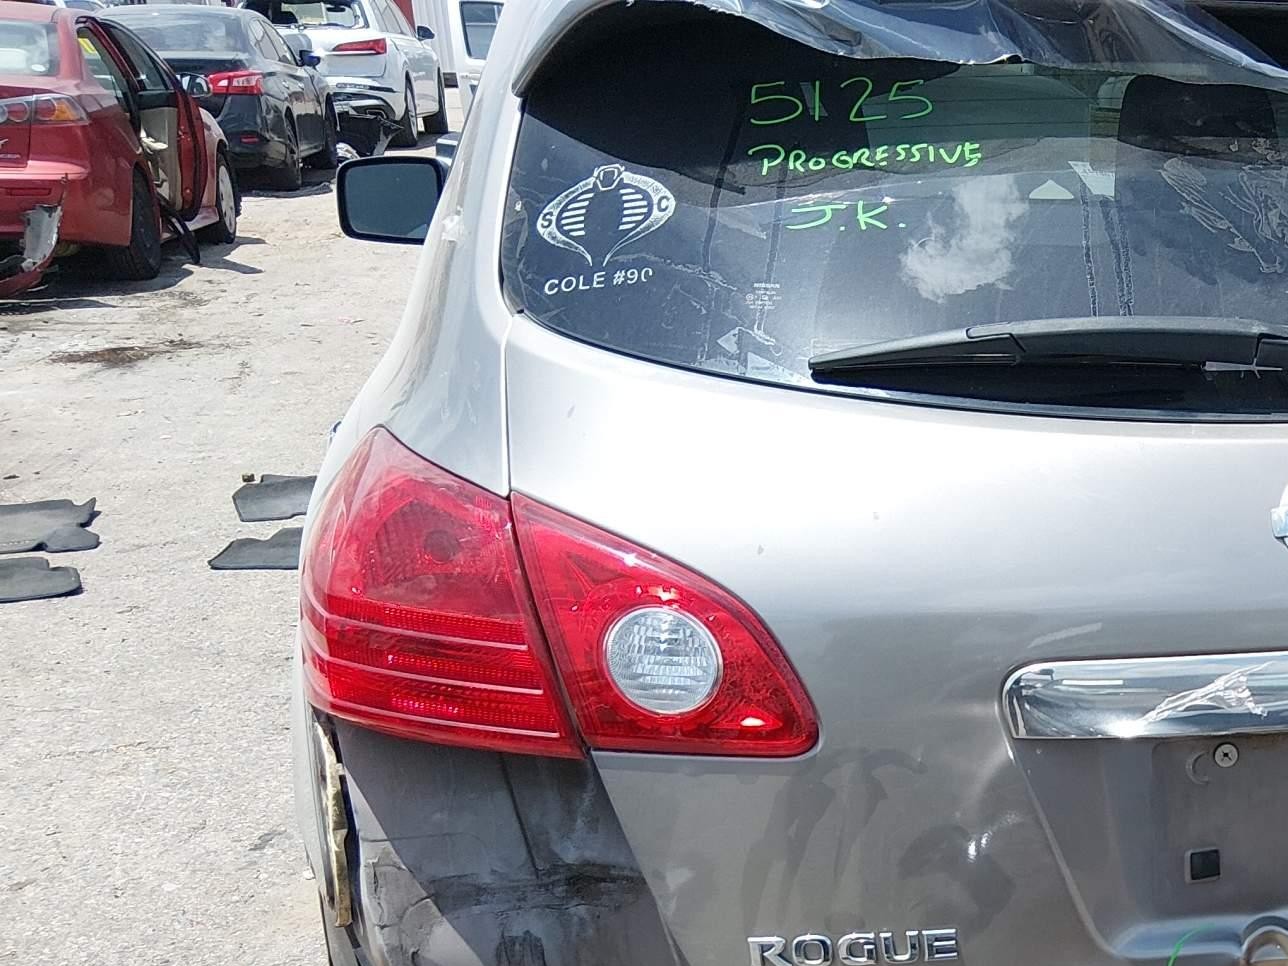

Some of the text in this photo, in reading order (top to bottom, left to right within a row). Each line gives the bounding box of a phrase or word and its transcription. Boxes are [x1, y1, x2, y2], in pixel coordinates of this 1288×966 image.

[751, 77, 933, 125] 5125
[748, 142, 982, 176] PROGRESSIVE
[544, 271, 606, 295] COLE
